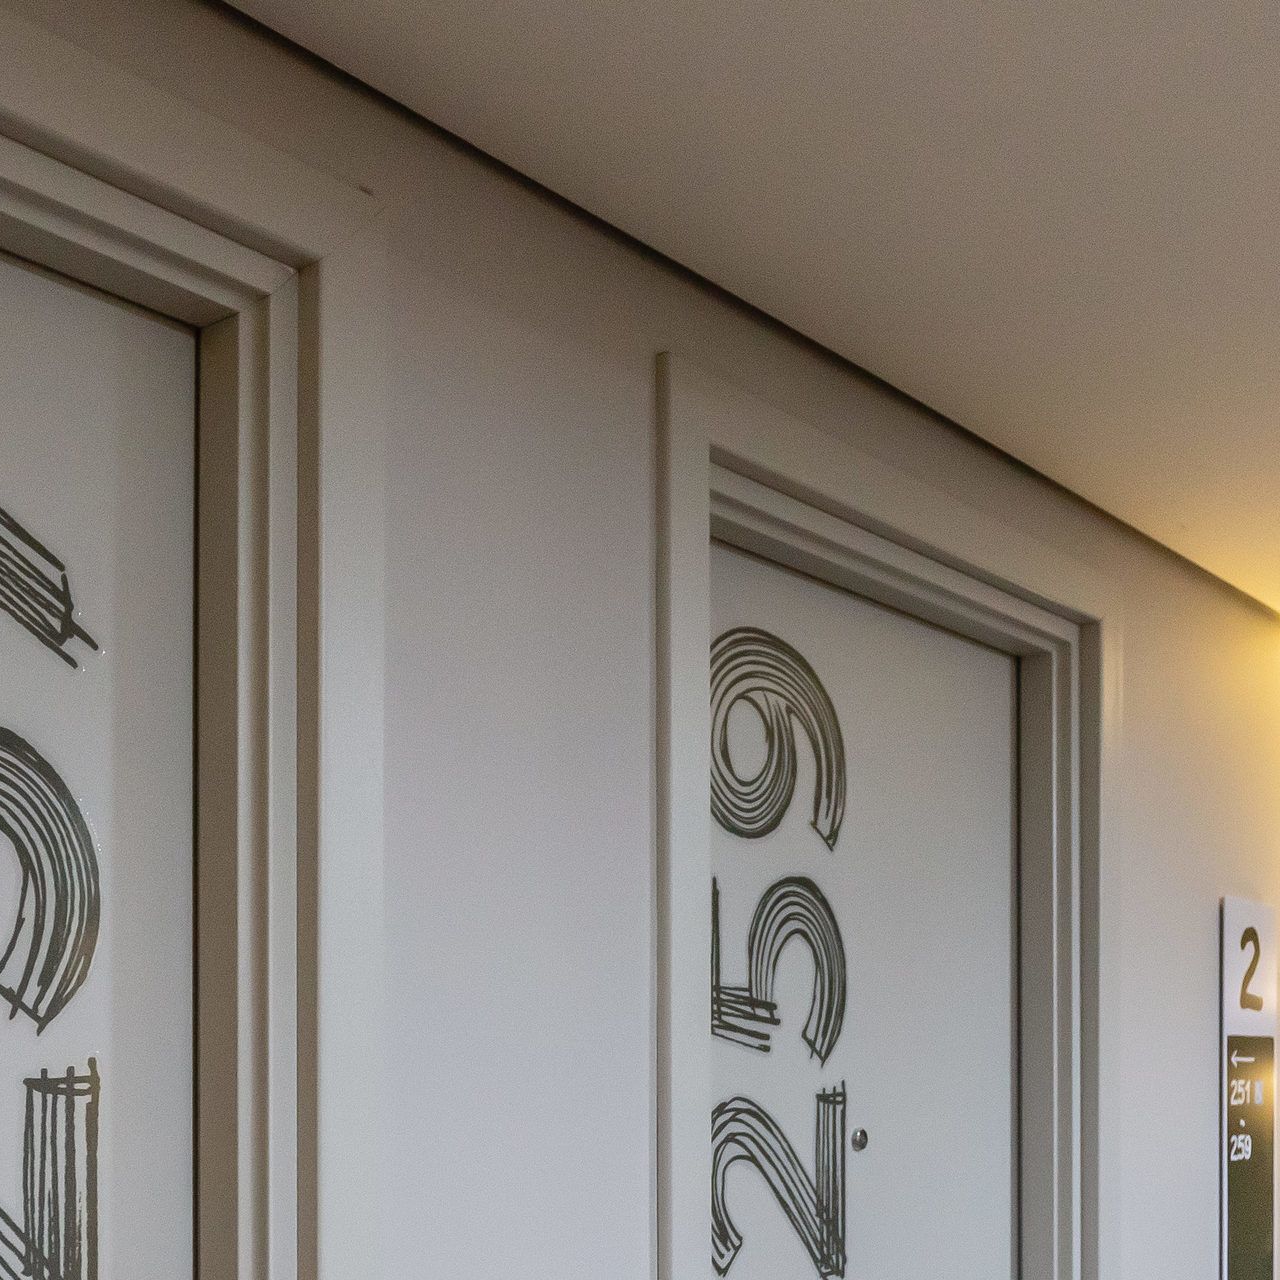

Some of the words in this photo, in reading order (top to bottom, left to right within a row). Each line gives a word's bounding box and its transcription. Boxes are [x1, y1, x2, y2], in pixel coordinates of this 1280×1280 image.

[1240, 926, 1263, 1012] 2
[1230, 1079, 1251, 1106] 251
[1230, 1133, 1252, 1162] 259
